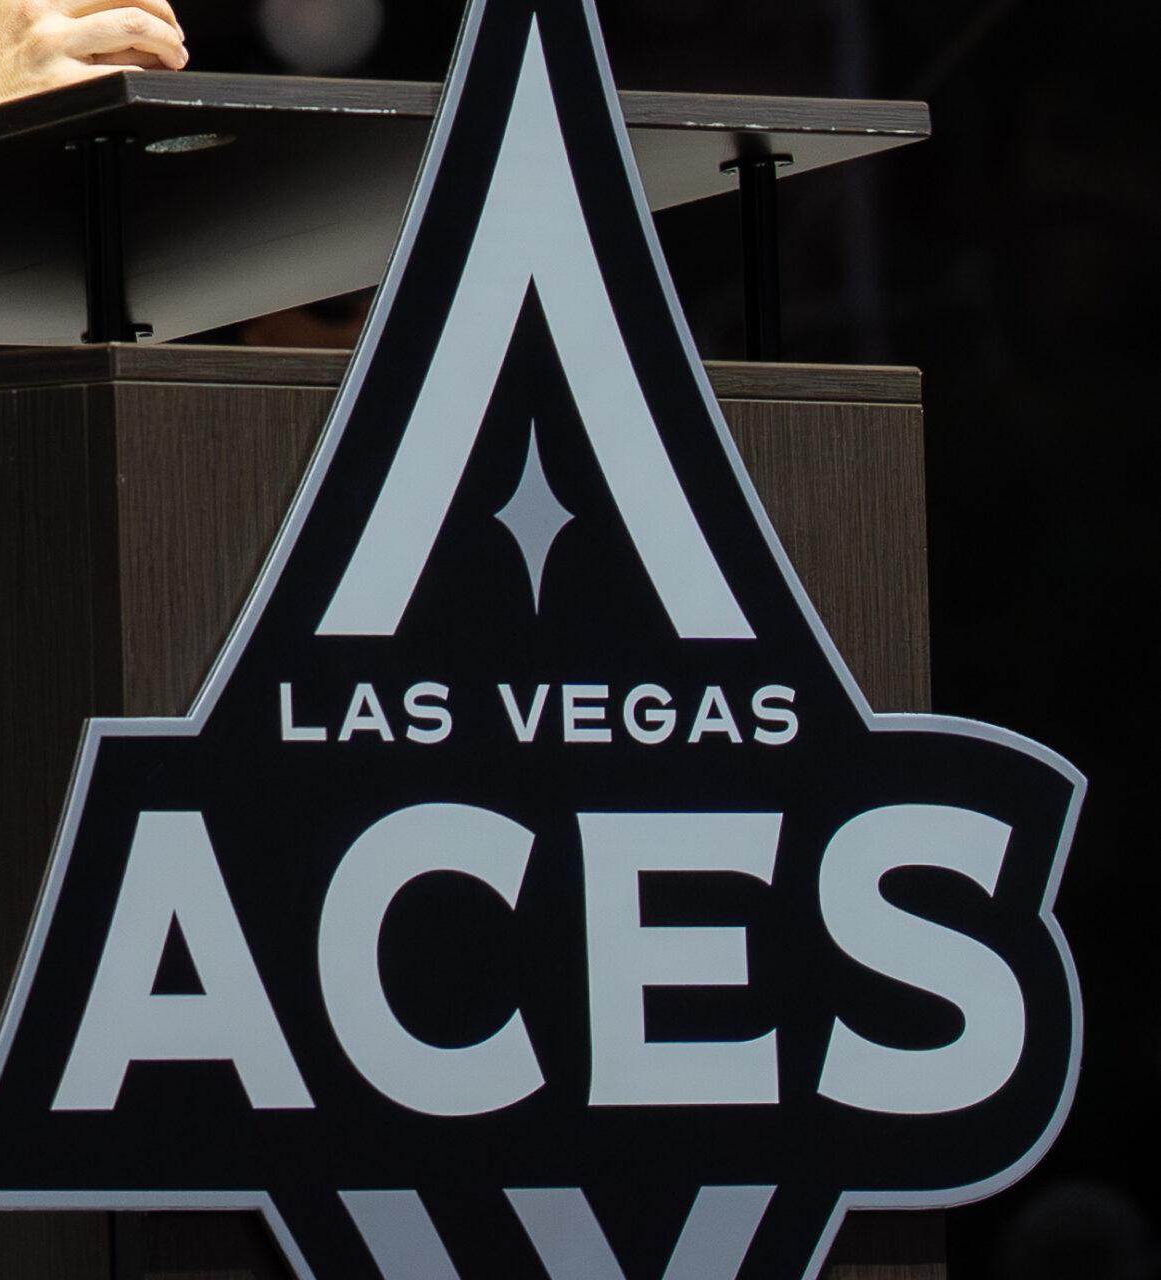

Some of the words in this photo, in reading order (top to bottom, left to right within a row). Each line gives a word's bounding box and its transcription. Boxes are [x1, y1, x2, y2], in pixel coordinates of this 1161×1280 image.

[279, 681, 453, 744] LAS
[497, 683, 799, 746] VEGAS
[50, 802, 1026, 1117] ACES
